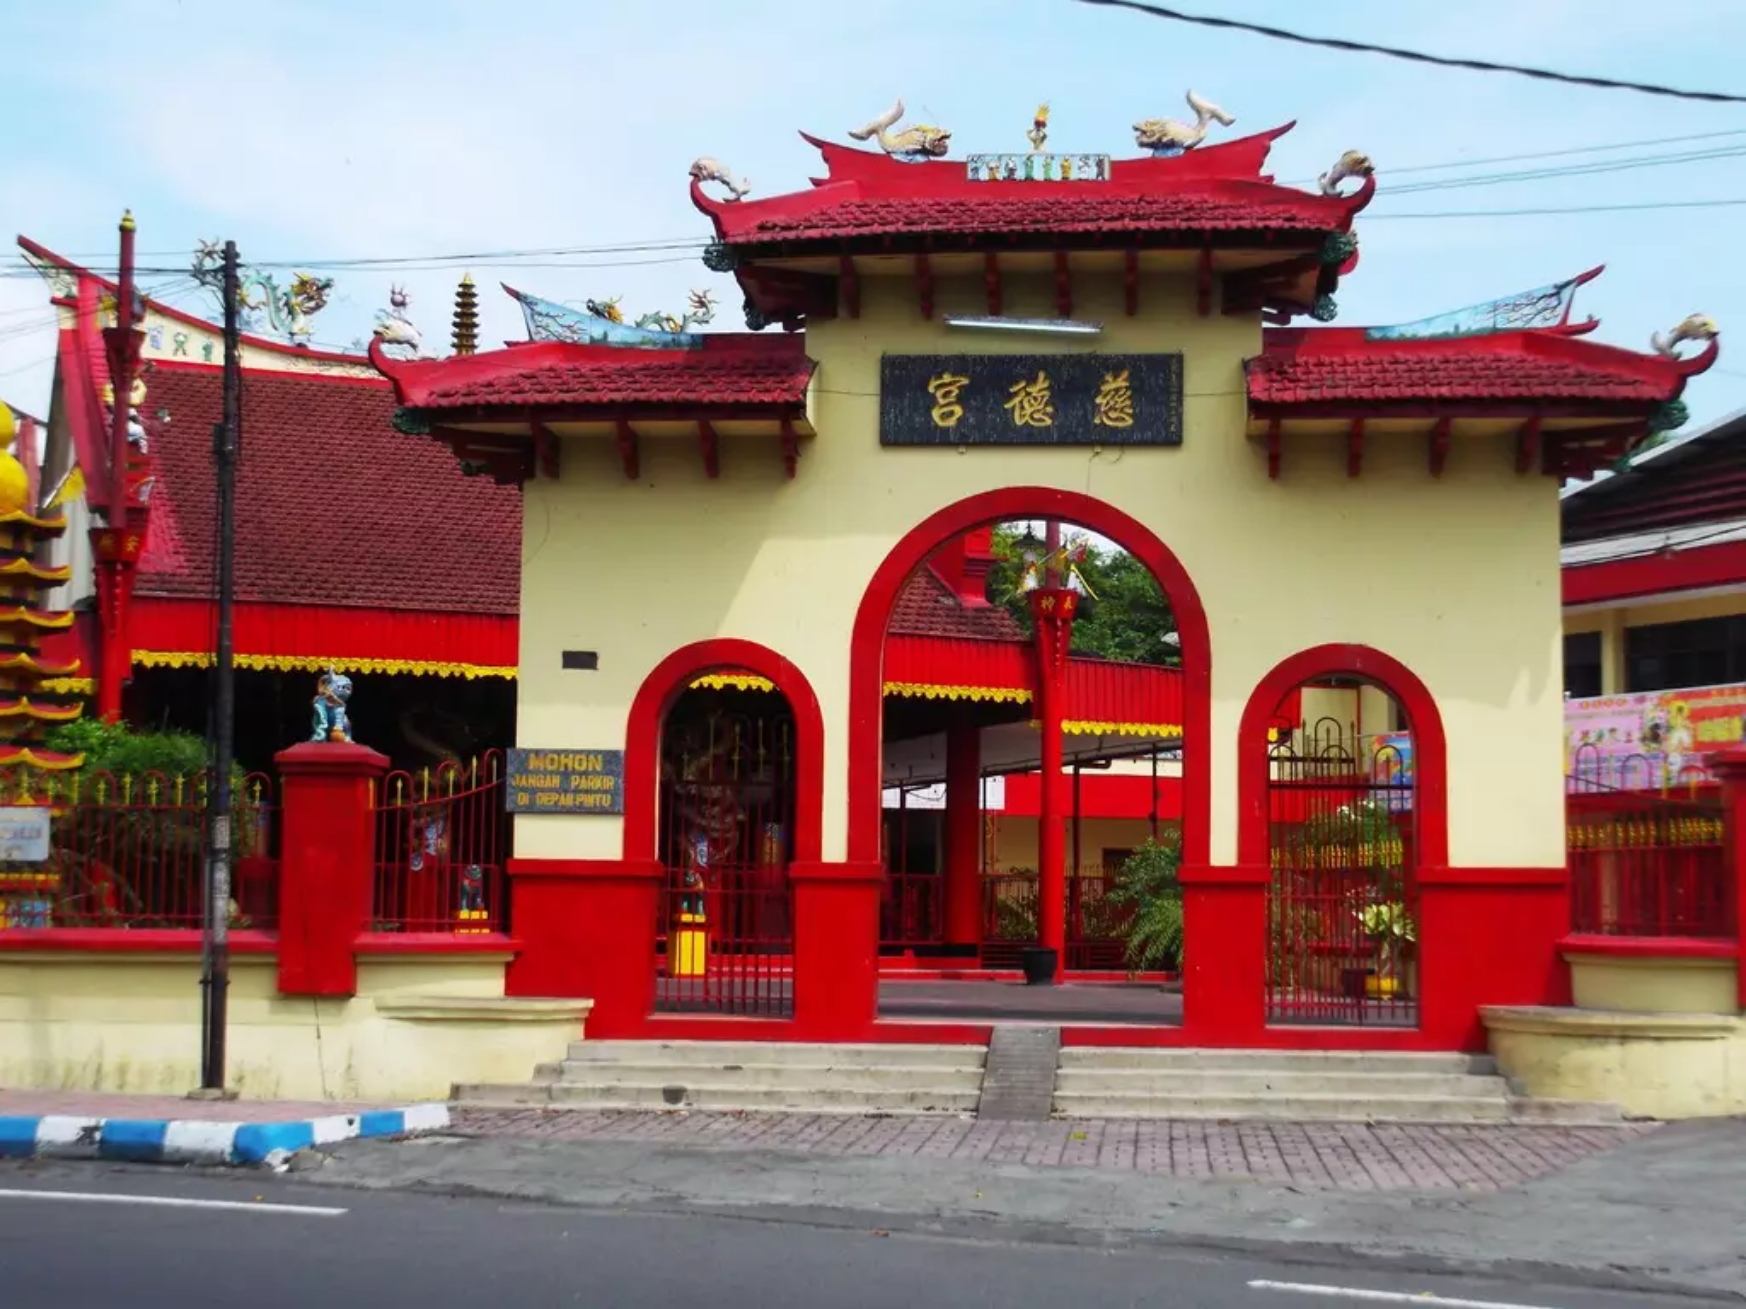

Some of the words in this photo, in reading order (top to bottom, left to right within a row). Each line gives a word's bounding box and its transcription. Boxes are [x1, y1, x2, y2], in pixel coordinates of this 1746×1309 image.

[528, 753, 602, 771] MOHON
[513, 774, 560, 788] JANGAN
[570, 775, 614, 790] PARKIR
[518, 792, 529, 805] DI
[536, 792, 573, 806] DEPAN
[576, 793, 611, 806] PINTU
